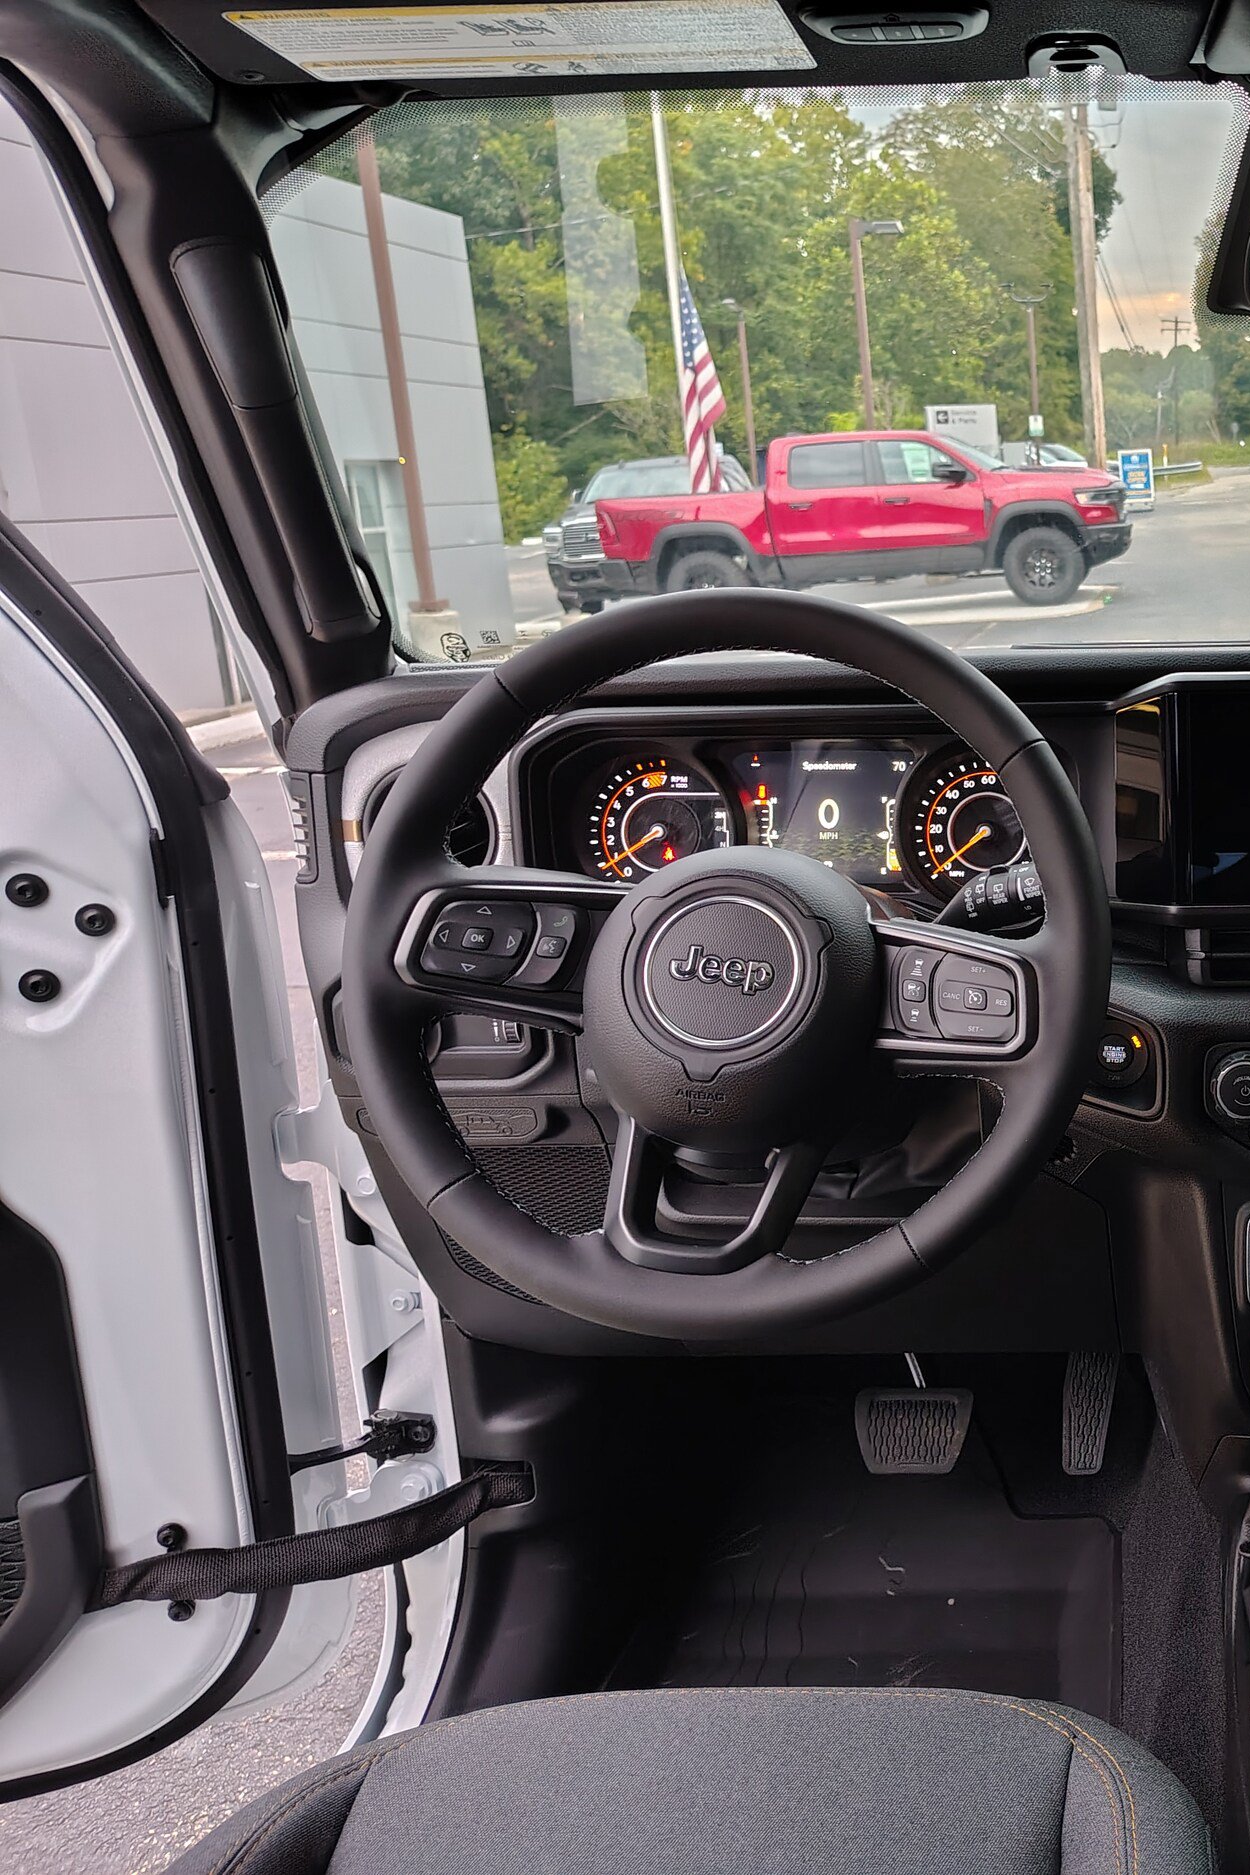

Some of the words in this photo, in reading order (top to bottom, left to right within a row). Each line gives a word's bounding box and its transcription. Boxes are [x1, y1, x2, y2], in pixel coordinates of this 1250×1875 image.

[802, 761, 858, 772] Speedometer
[642, 778, 650, 788] 6
[660, 775, 668, 785] 7
[963, 780, 975, 788] 50
[981, 775, 996, 785] 60
[625, 786, 634, 797] 5
[945, 789, 959, 800] 40
[612, 800, 622, 810] 4
[817, 798, 840, 830] 0
[935, 806, 947, 815] 30
[606, 816, 615, 828] 3
[929, 824, 943, 834] 20
[606, 835, 615, 846] 2
[819, 831, 839, 840] MPH
[934, 845, 944, 853] 10
[623, 866, 633, 877] 0
[949, 870, 965, 878] MPH
[470, 933, 485, 943] OK
[669, 944, 776, 996] Jeep
[942, 991, 961, 1000] CANC
[994, 998, 1008, 1007] RES
[674, 1088, 726, 1102] AIRBAG
